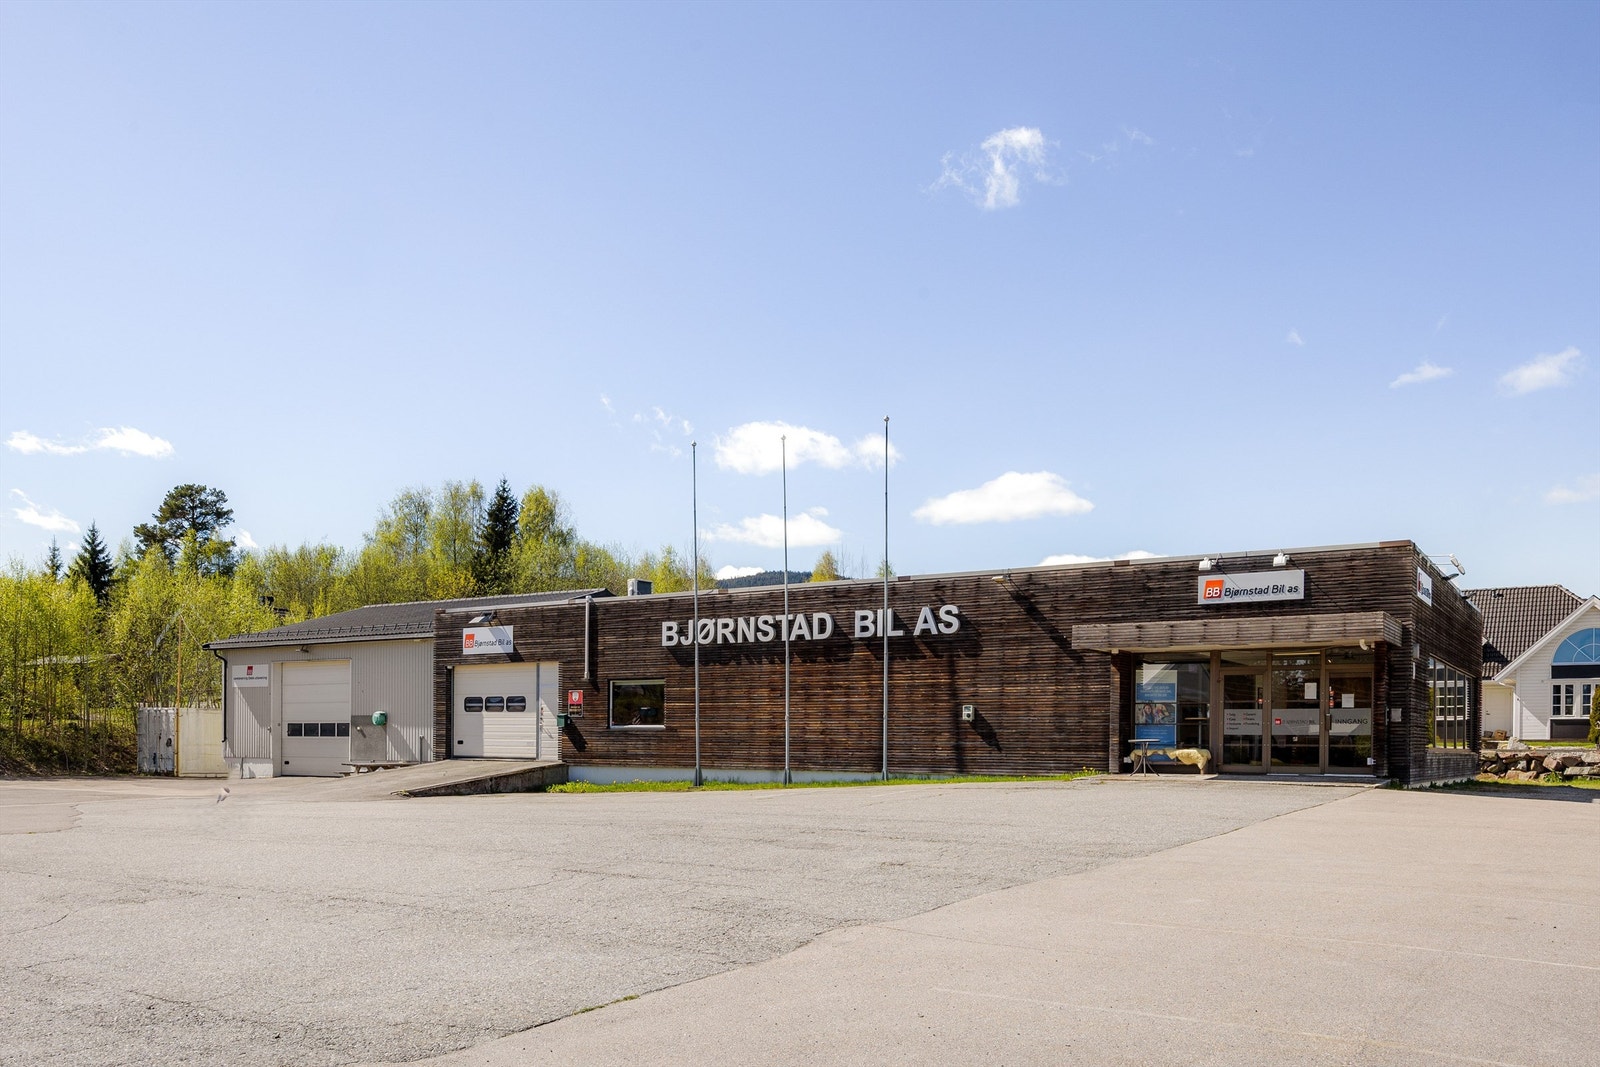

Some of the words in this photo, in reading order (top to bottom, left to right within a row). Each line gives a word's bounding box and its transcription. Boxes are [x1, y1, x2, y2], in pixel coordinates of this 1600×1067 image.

[1205, 587, 1221, 597] BB
[1224, 585, 1270, 598] Bjørnstad
[1271, 584, 1285, 594] Bil
[1287, 585, 1299, 593] as
[661, 612, 833, 646] BJØRNSTAD
[854, 608, 904, 638] BIL
[913, 604, 960, 635] AS
